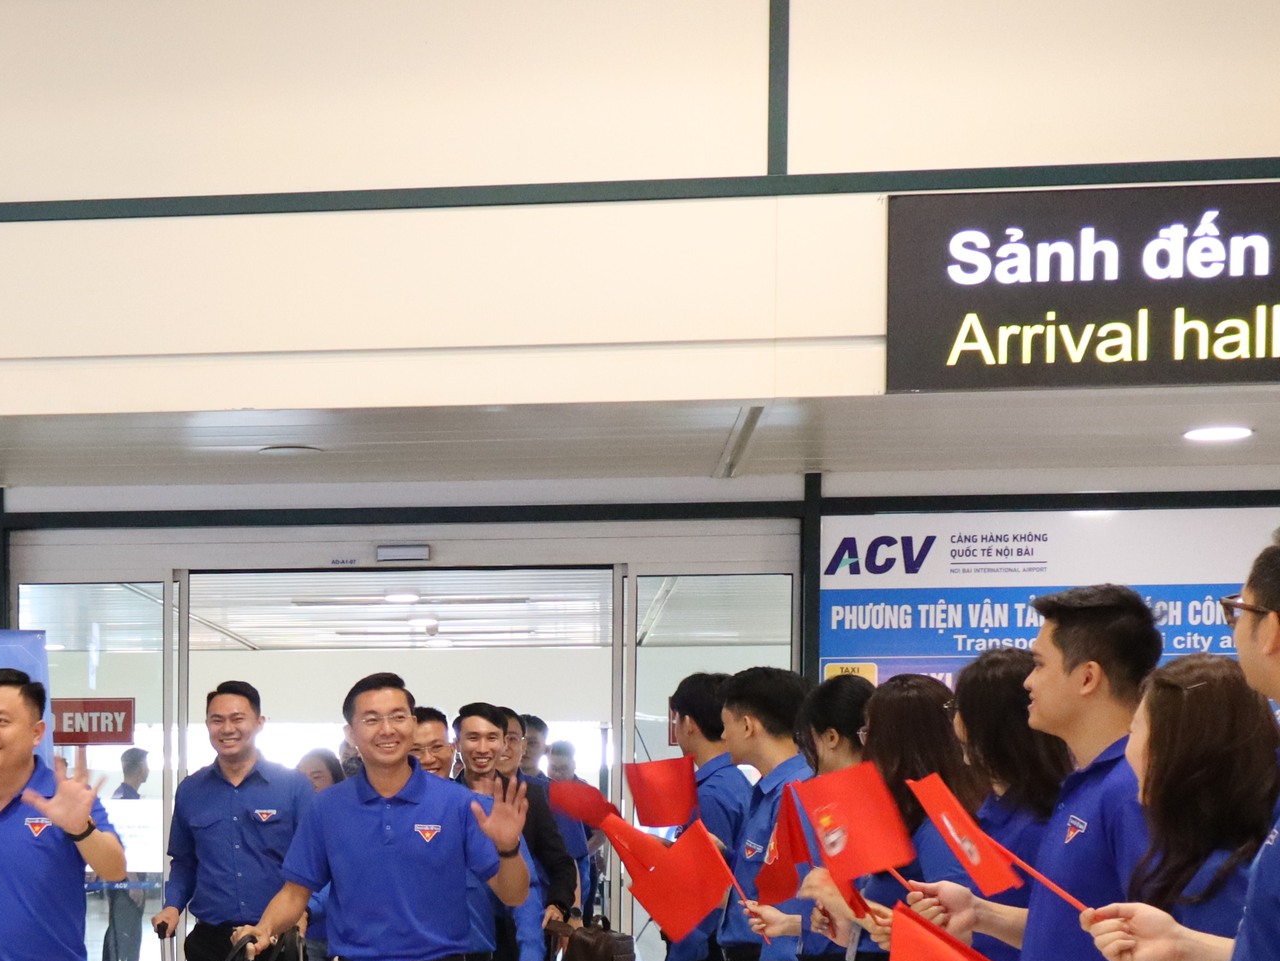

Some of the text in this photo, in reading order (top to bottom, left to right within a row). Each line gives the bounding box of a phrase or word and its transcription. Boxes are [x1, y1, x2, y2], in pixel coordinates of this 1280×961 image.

[947, 211, 1270, 286] Sảnh đến
[946, 304, 1280, 366] Arrival hall
[950, 532, 1048, 544] CẢNG HÀNG KHÔNG
[823, 536, 937, 575] ACV
[950, 545, 1034, 560] QUỐC TẾ NỘI BÀI
[831, 602, 913, 630] PHƯƠNG
[918, 599, 963, 634] TIỆN
[968, 598, 1009, 634] VẬN
[1187, 595, 1230, 626] CÔN
[1172, 632, 1213, 652] city
[839, 666, 860, 674] TAXI
[62, 711, 127, 733] ENTRY
